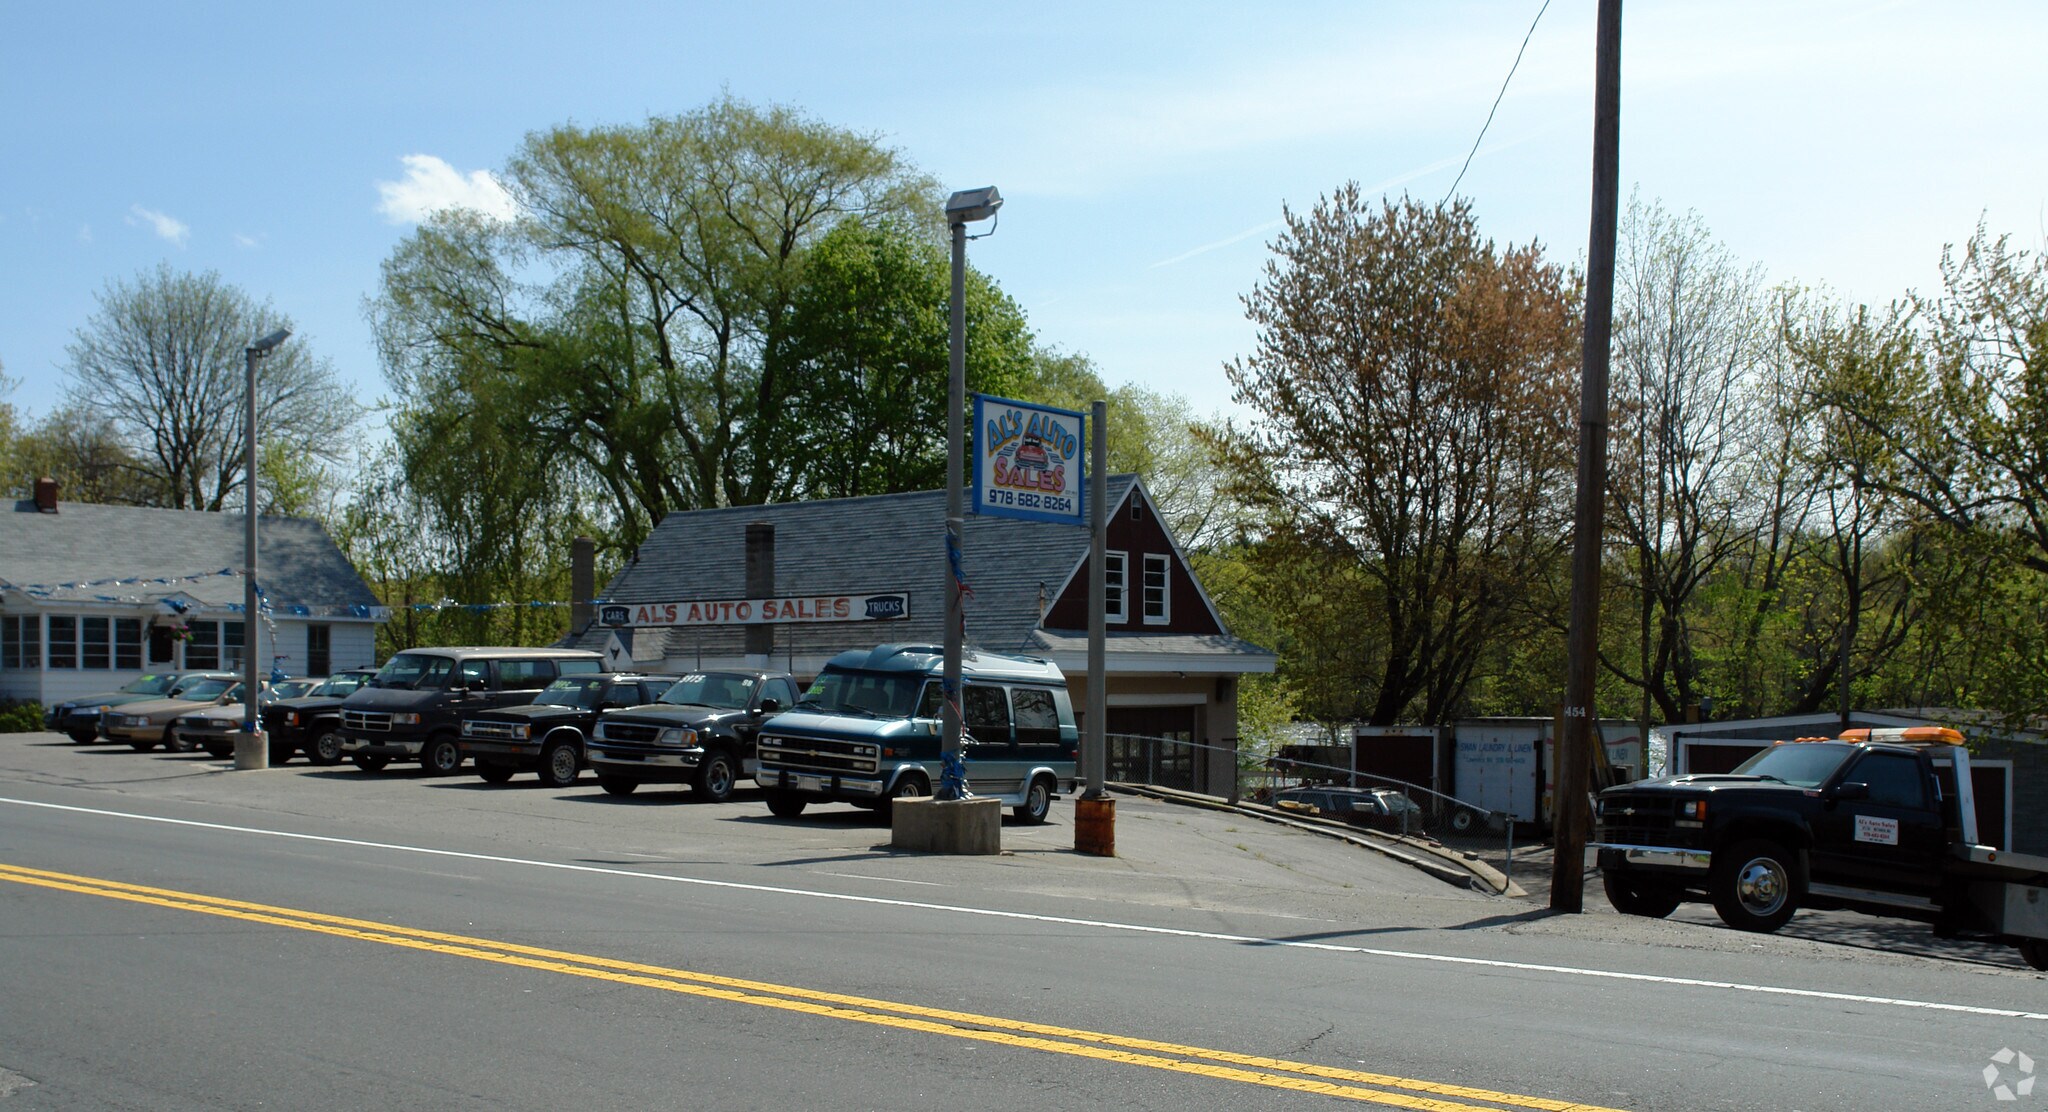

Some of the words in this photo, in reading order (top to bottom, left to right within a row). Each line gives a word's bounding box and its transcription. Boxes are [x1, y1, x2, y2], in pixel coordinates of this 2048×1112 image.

[987, 409, 1023, 454] AL'S
[1027, 412, 1077, 460] AUTO
[994, 456, 1066, 494] SALES
[636, 604, 677, 624] AL'S
[687, 601, 752, 622] AUTO
[762, 598, 850, 620] SALES
[868, 601, 900, 613] TRUCKS
[605, 611, 624, 621] CARS
[1565, 706, 1586, 717] 454
[1460, 742, 1477, 752] SWAN
[1479, 743, 1506, 752] LAUNDRY
[1514, 743, 1532, 752] LINEN
